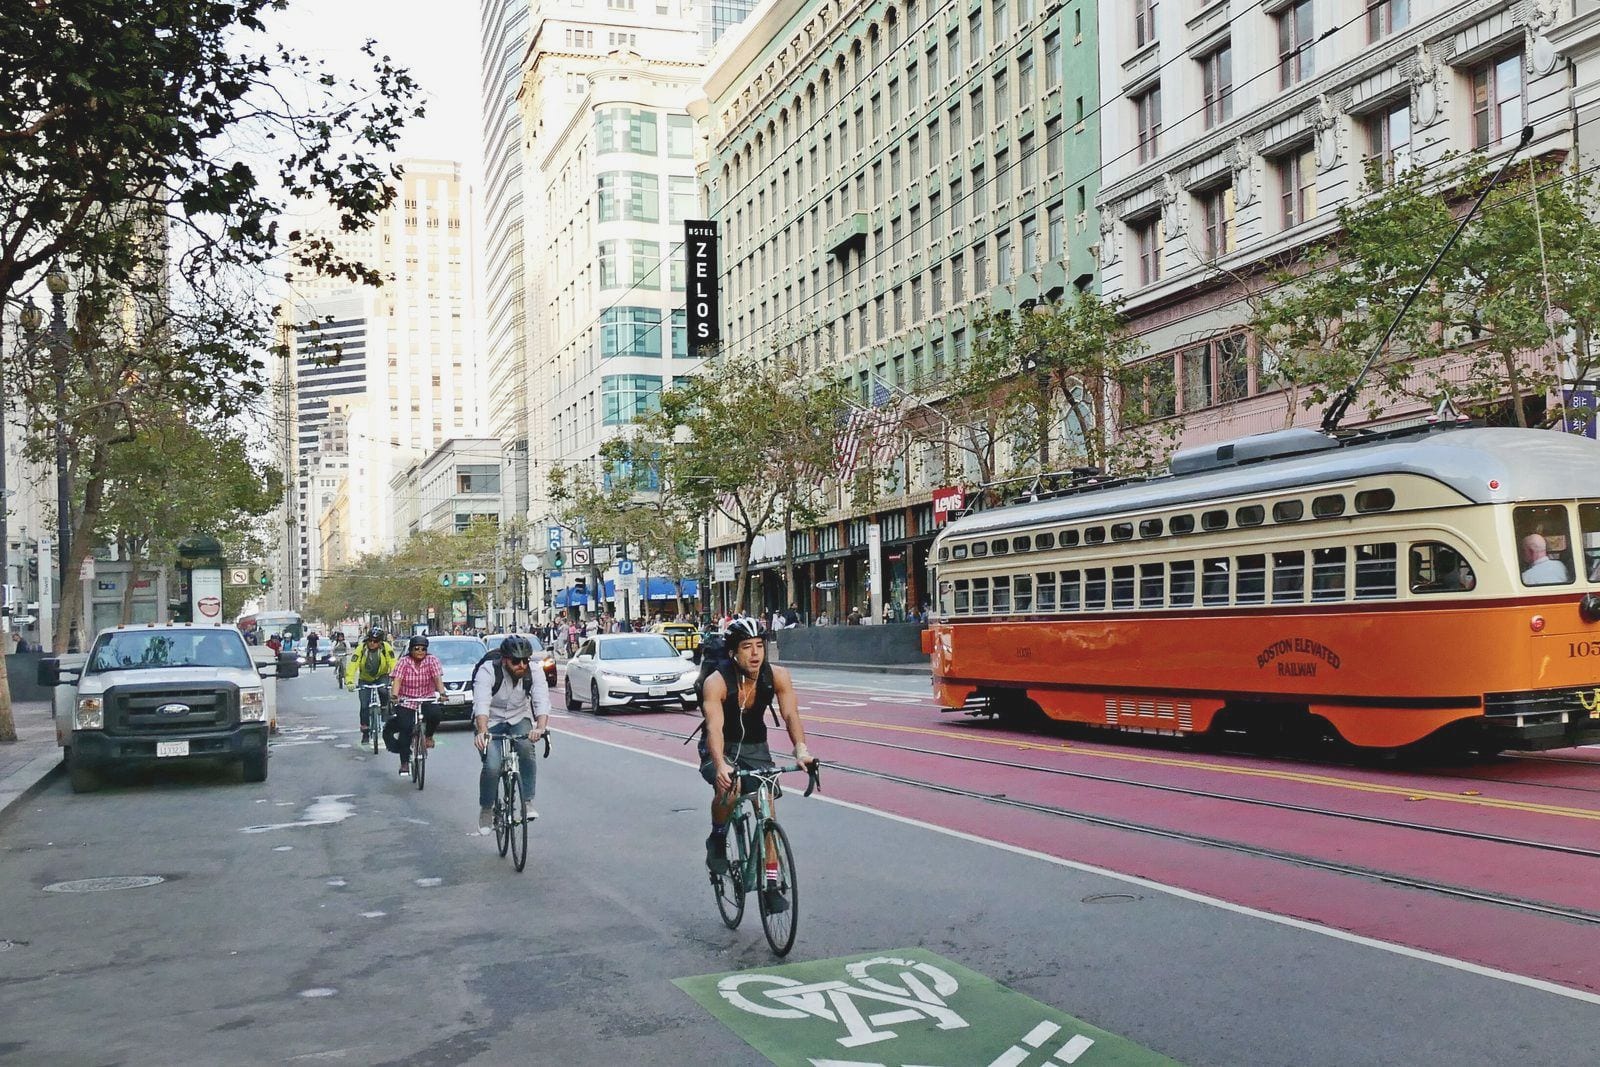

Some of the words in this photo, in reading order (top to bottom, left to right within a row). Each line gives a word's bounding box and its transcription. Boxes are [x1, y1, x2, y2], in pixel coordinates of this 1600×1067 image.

[688, 228, 714, 236] HOTEL
[696, 242, 709, 338] ZELOS
[1257, 639, 1293, 669] BOSTON
[1295, 637, 1340, 670] ELEVATED
[1277, 662, 1317, 676] RAILWAY
